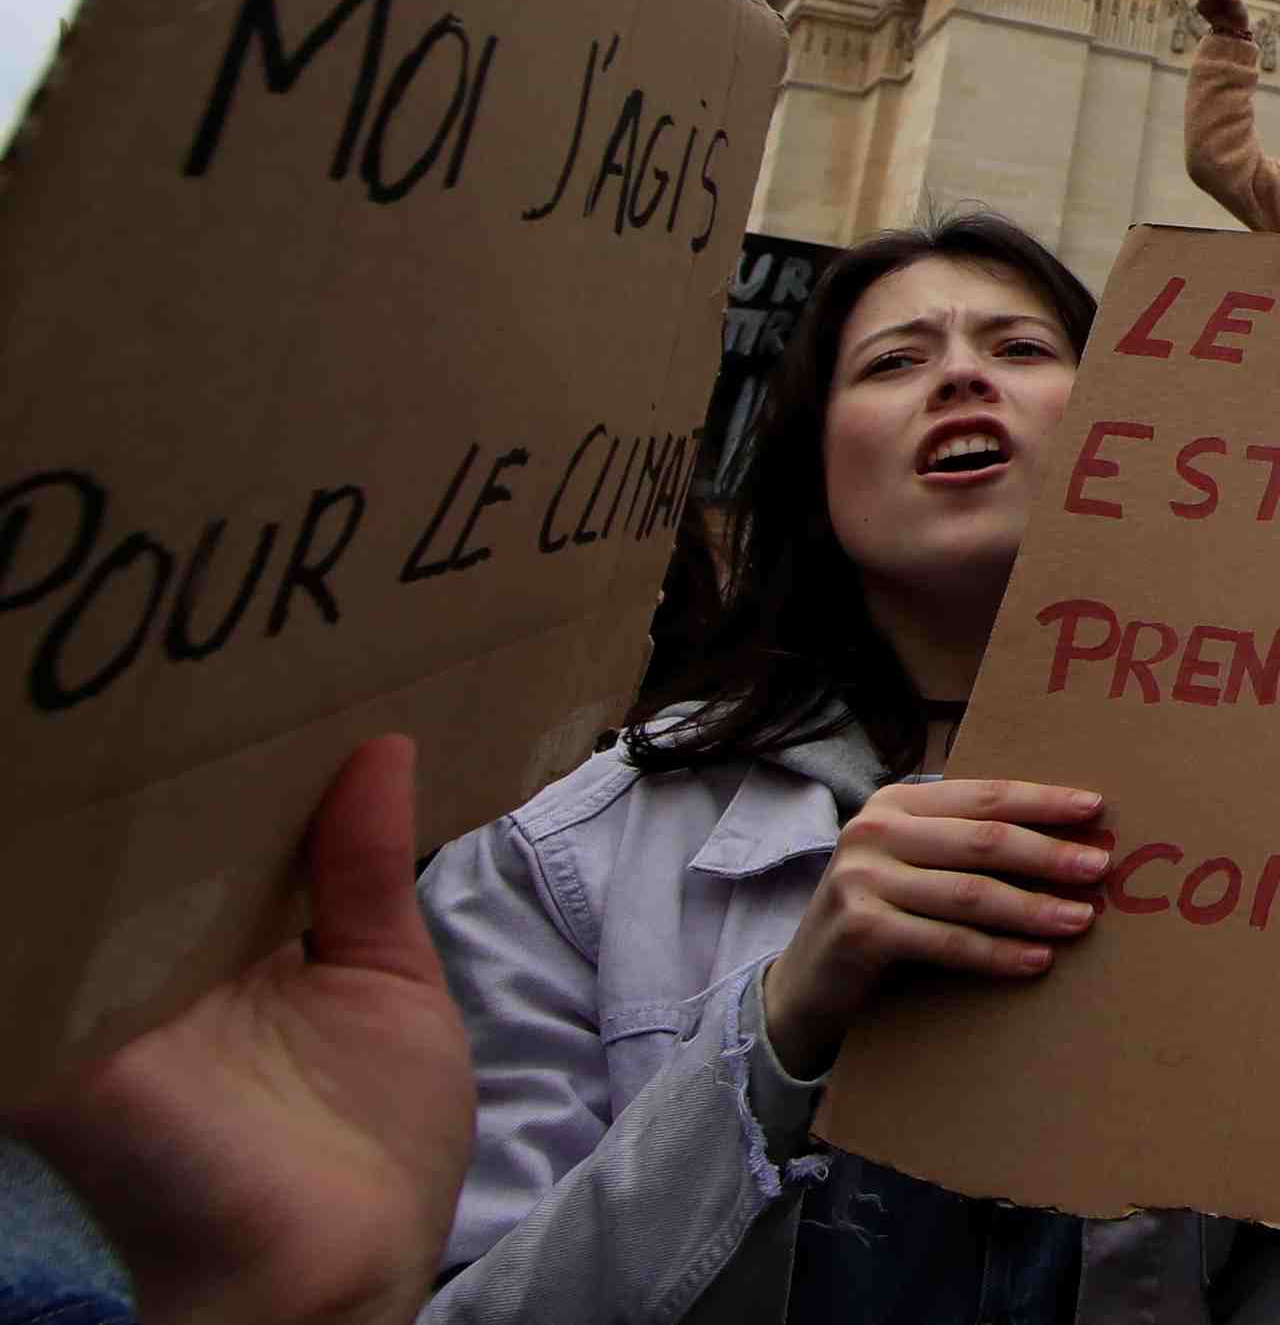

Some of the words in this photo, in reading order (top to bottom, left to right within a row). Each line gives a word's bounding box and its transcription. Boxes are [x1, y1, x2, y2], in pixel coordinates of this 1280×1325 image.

[1114, 276, 1278, 365] LE
[0, 470, 366, 713] POUR
[400, 442, 530, 585] LE
